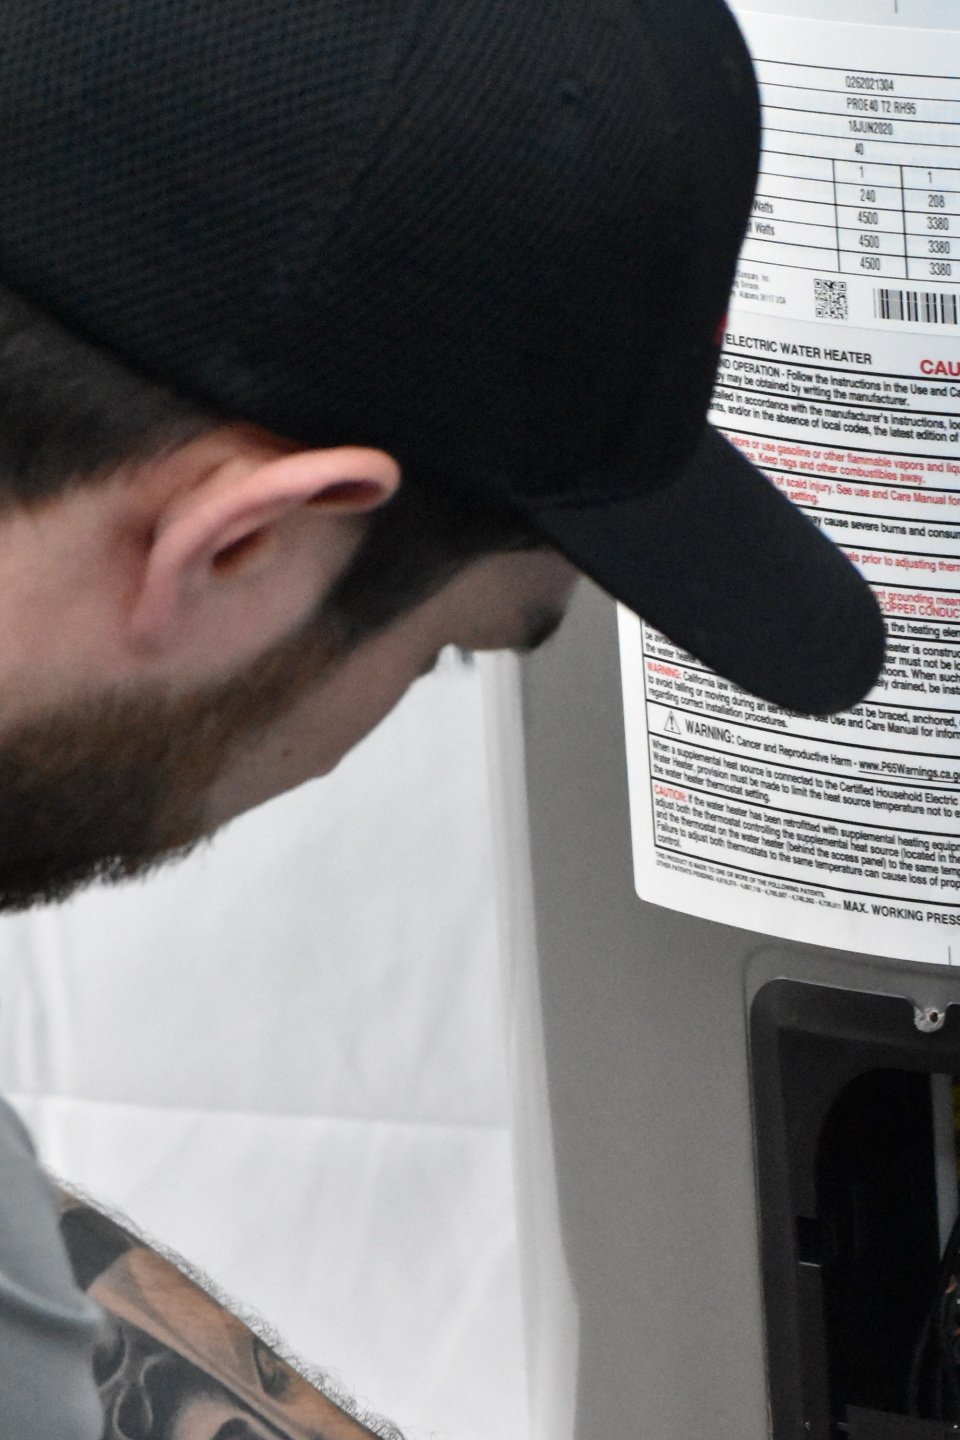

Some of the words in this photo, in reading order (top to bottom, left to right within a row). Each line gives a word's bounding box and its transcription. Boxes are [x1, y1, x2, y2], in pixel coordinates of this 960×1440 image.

[881, 101, 892, 113] T2
[849, 120, 893, 135] 18JUN2020
[855, 143, 864, 155] 40
[860, 166, 864, 177] 1
[927, 172, 932, 183] 1
[860, 189, 876, 203] 240
[928, 194, 945, 208] 208
[857, 211, 878, 225] 4500
[927, 217, 949, 231] 3380
[859, 235, 879, 249] 4500
[928, 240, 950, 254] 3380
[860, 257, 881, 271] 4500
[929, 263, 951, 277] 3380
[725, 334, 777, 352] ELECTRIC
[780, 343, 821, 358] WATER
[824, 349, 872, 365] HEATER
[733, 361, 780, 377] OPERATION
[787, 370, 812, 383] Follow
[815, 374, 828, 385] the
[883, 381, 891, 391] in
[894, 383, 908, 393] the
[910, 384, 928, 395] Use
[930, 387, 948, 396] and
[685, 719, 735, 744] WARNING:
[737, 735, 762, 750] Cancer
[764, 743, 777, 753] and
[779, 744, 829, 762] Reproductive
[831, 755, 852, 767] Harm
[843, 900, 868, 914] MAX.
[872, 904, 924, 921] WORKING
